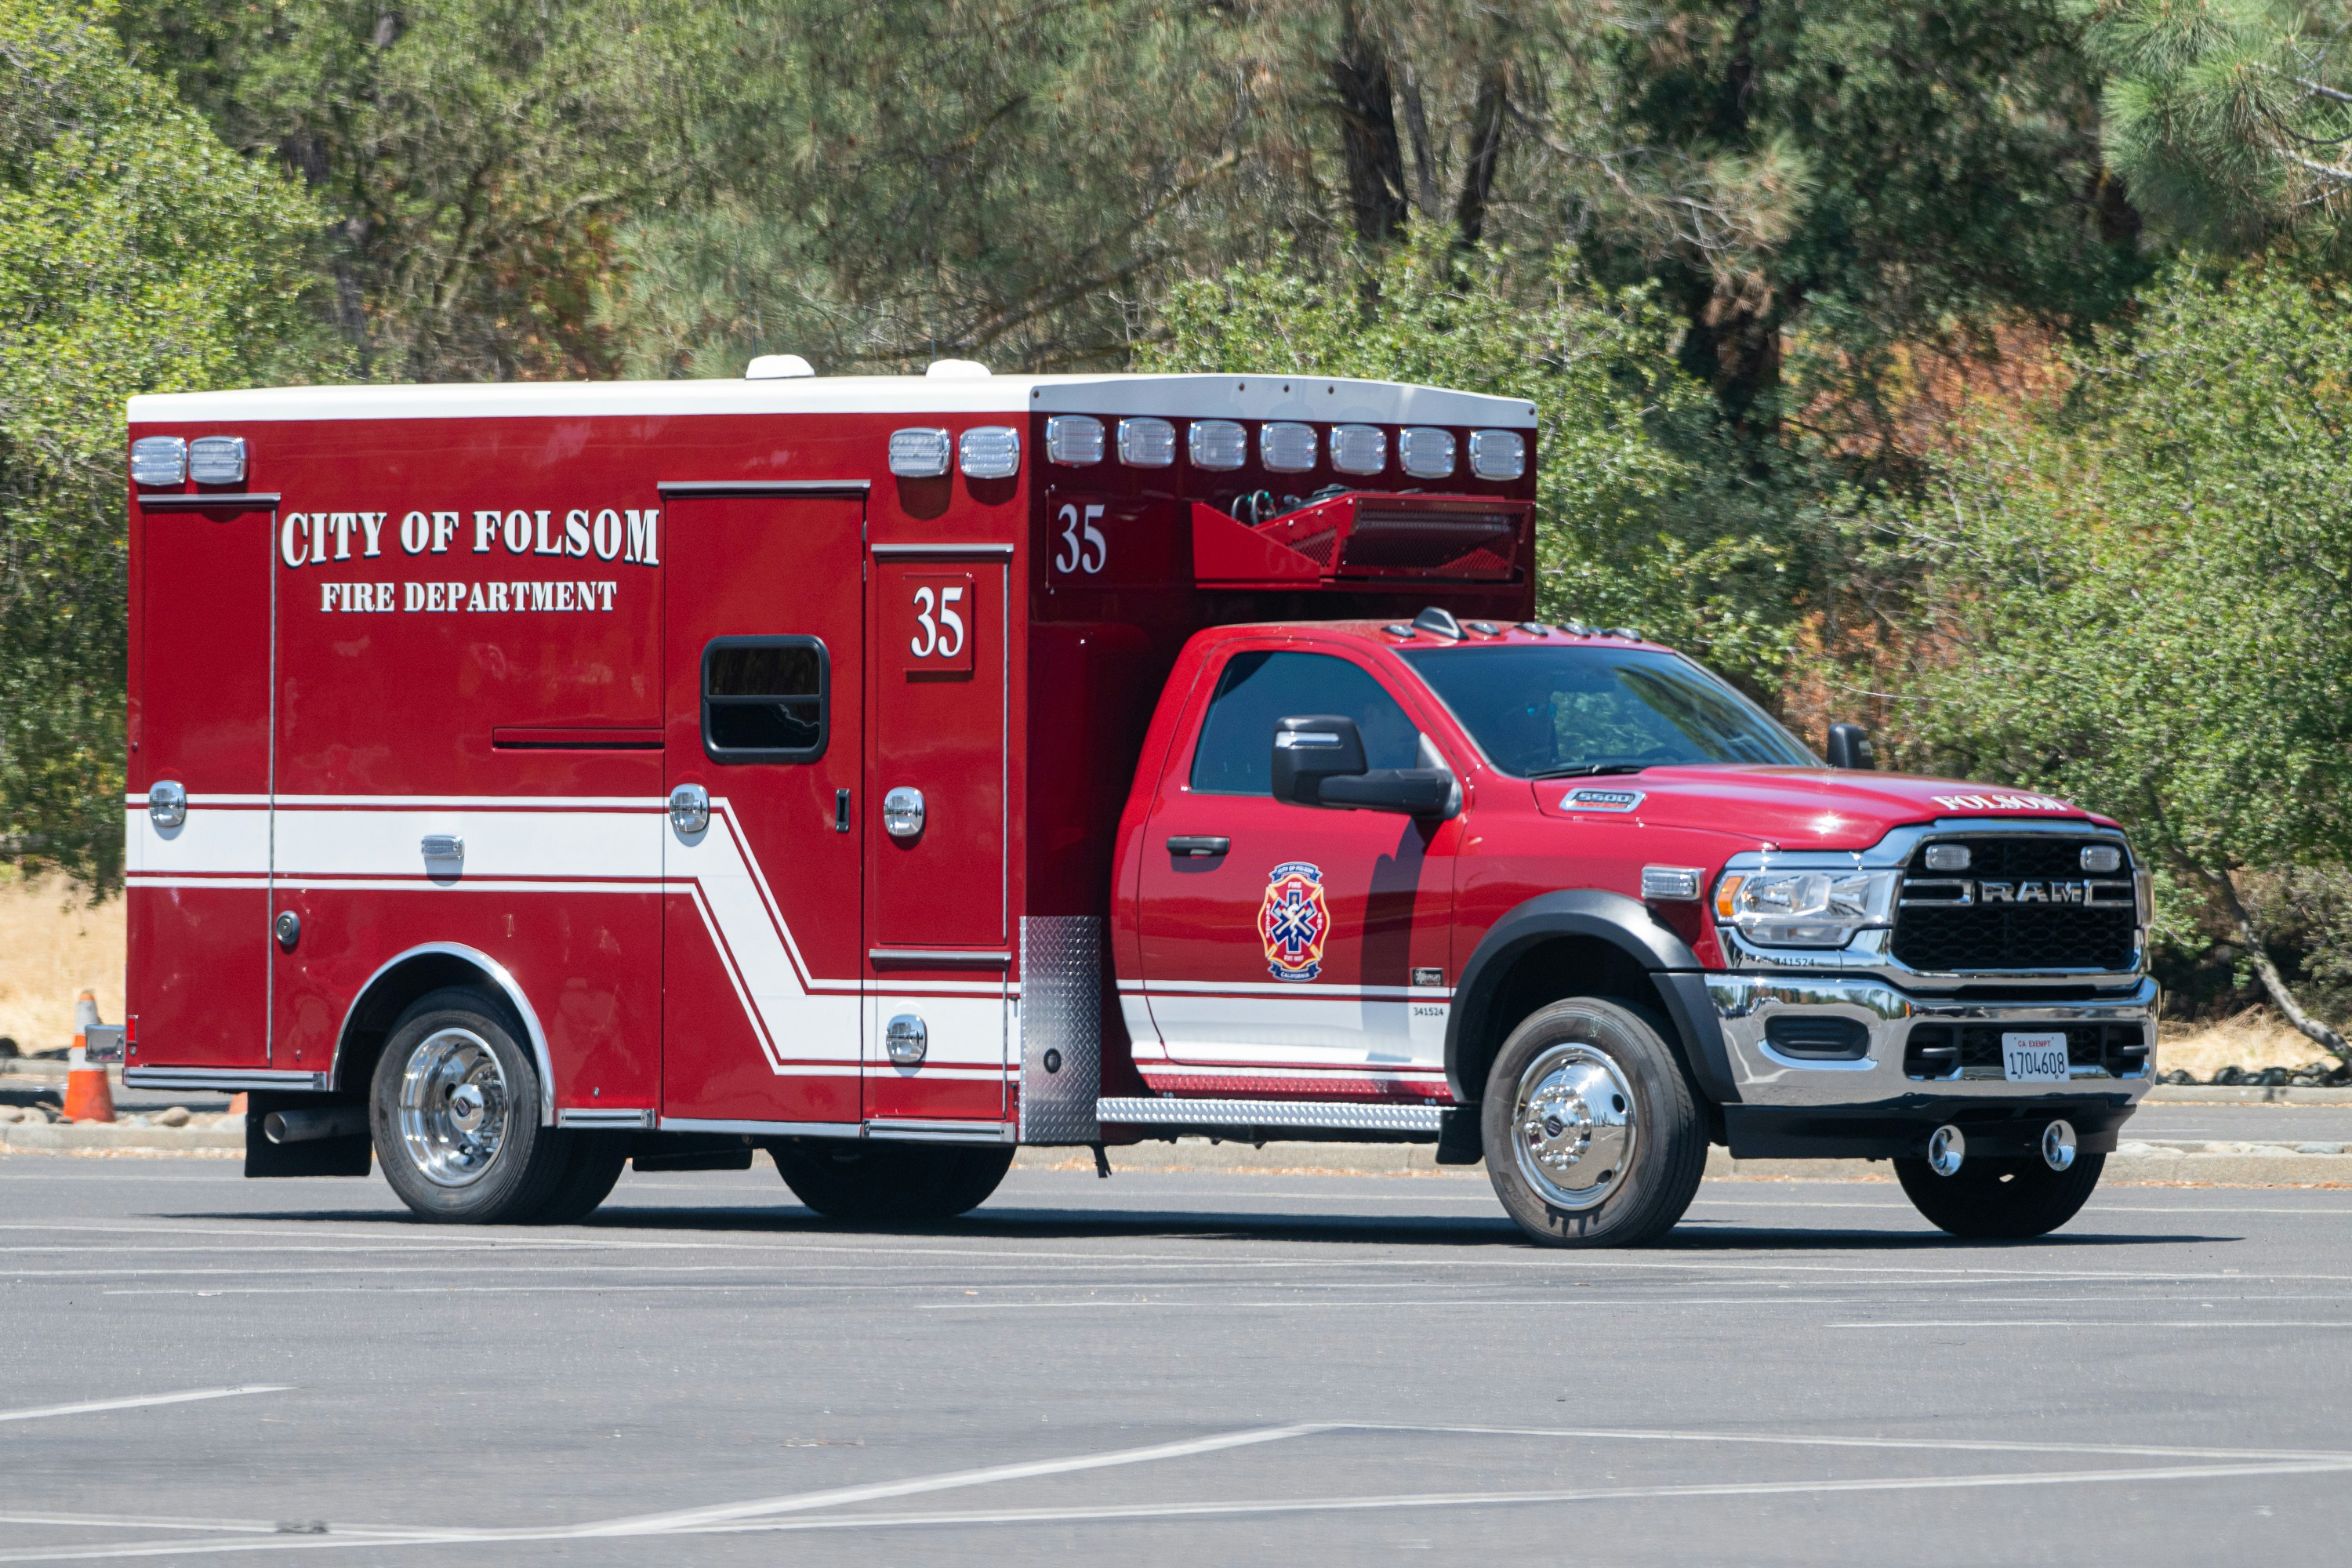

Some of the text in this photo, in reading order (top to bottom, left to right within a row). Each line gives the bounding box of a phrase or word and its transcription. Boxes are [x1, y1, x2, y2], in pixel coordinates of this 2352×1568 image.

[281, 508, 660, 568] CITY OF FOLSOM
[1055, 503, 1106, 574] 35
[320, 580, 617, 613] FIRE DEPARTMENT
[910, 586, 964, 658] 35
[1577, 792, 1630, 803] 5500
[1930, 794, 2068, 811] FOLSOM
[1980, 880, 2082, 902] RAM
[1414, 1007, 1444, 1016] 341524
[2028, 1040, 2051, 1048] EXEMPT
[2009, 1051, 2065, 1075] 1704608
